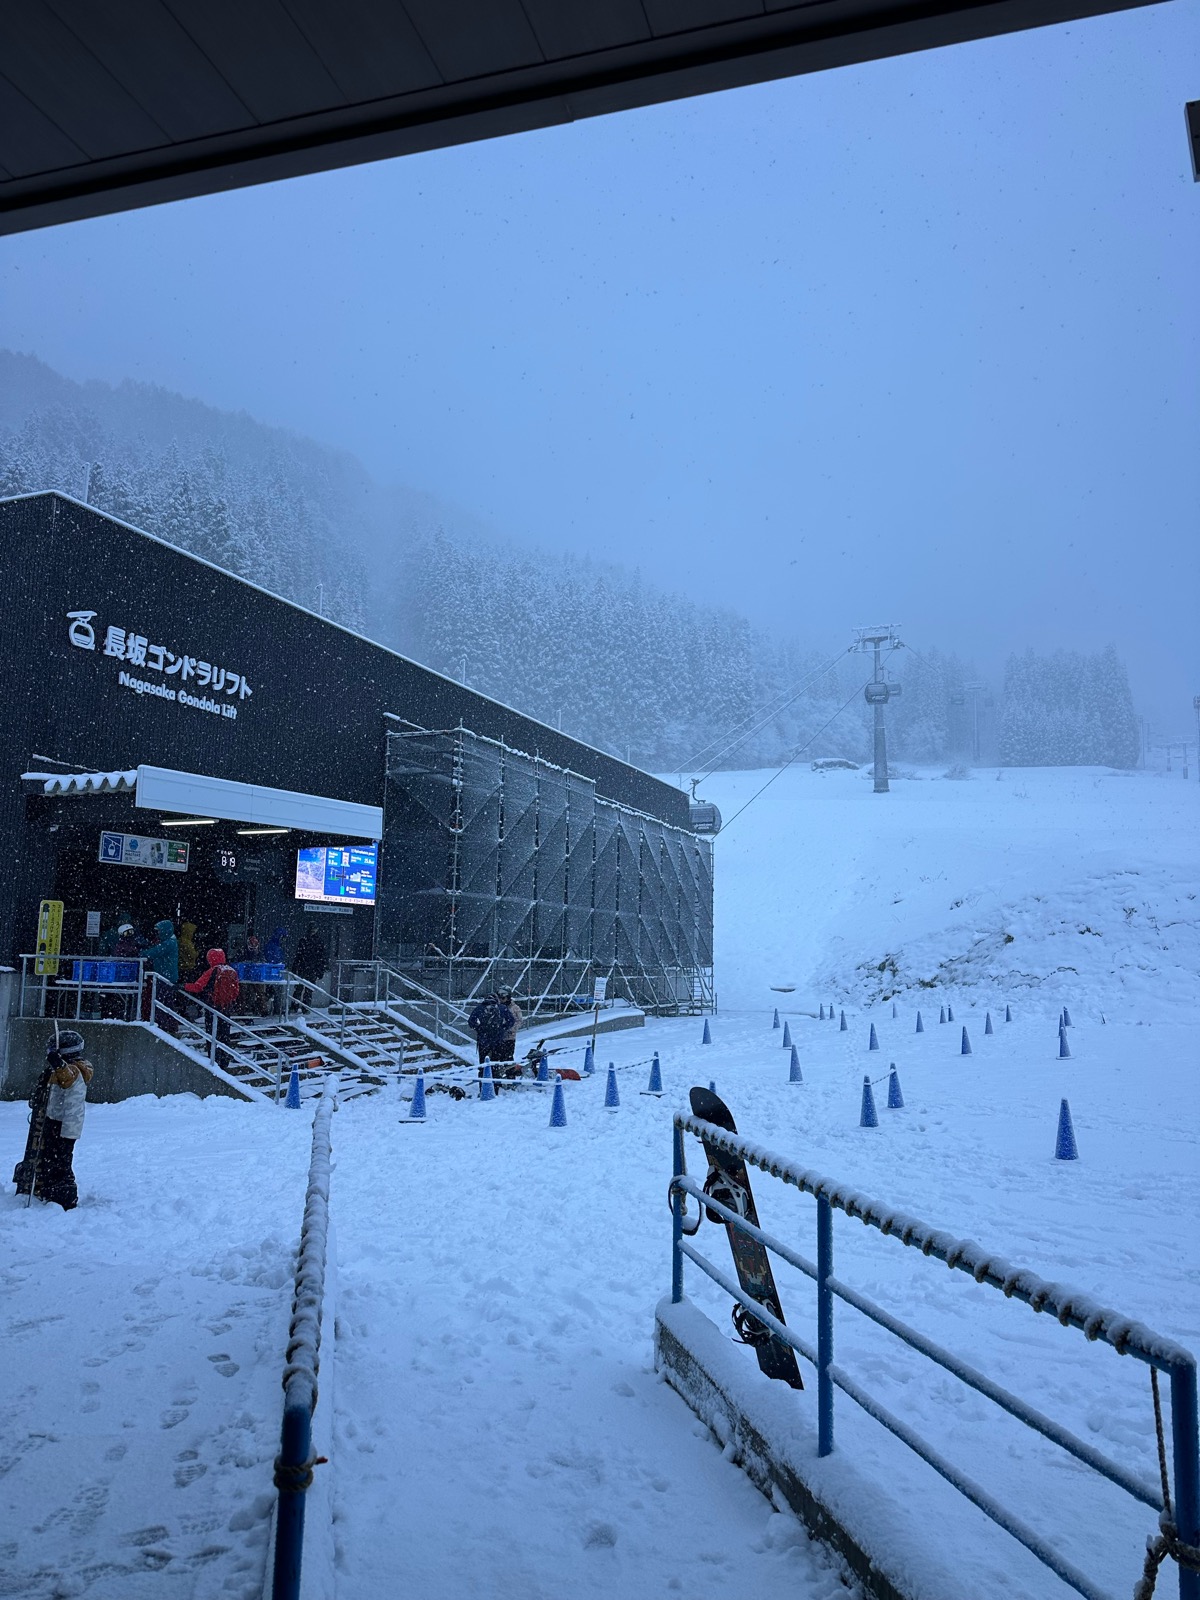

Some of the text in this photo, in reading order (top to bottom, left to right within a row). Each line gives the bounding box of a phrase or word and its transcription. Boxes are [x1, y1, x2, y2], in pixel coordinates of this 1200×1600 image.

[103, 625, 253, 700] 長坂ゴンドラリフト
[118, 671, 237, 720] Nagasaka Gondola Lift
